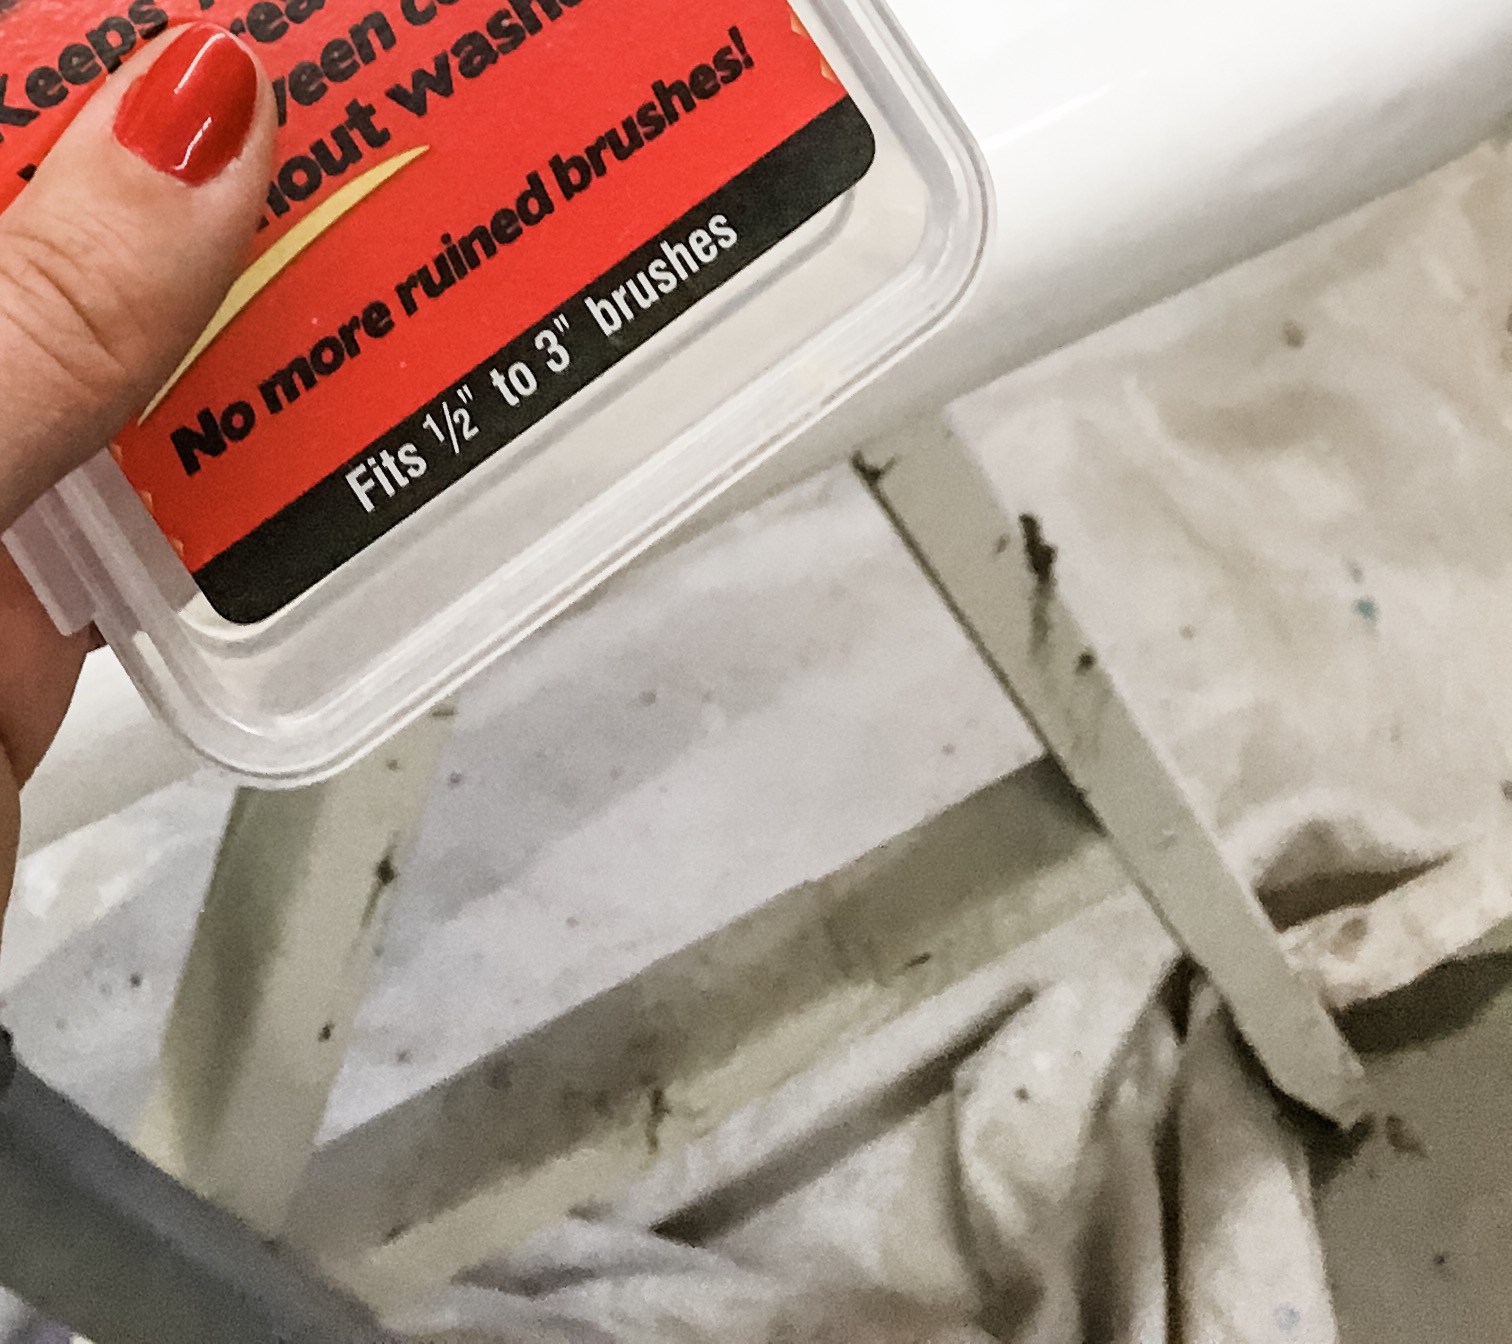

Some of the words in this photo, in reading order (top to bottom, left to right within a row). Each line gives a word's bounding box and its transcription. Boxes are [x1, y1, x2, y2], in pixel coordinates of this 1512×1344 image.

[169, 394, 256, 477] No
[259, 299, 395, 417] more
[394, 175, 556, 316] ruined
[551, 26, 756, 201] brushes!
[345, 437, 428, 513] Fits
[491, 360, 538, 408] to
[535, 315, 573, 374] 3"
[585, 213, 739, 338] brushes
